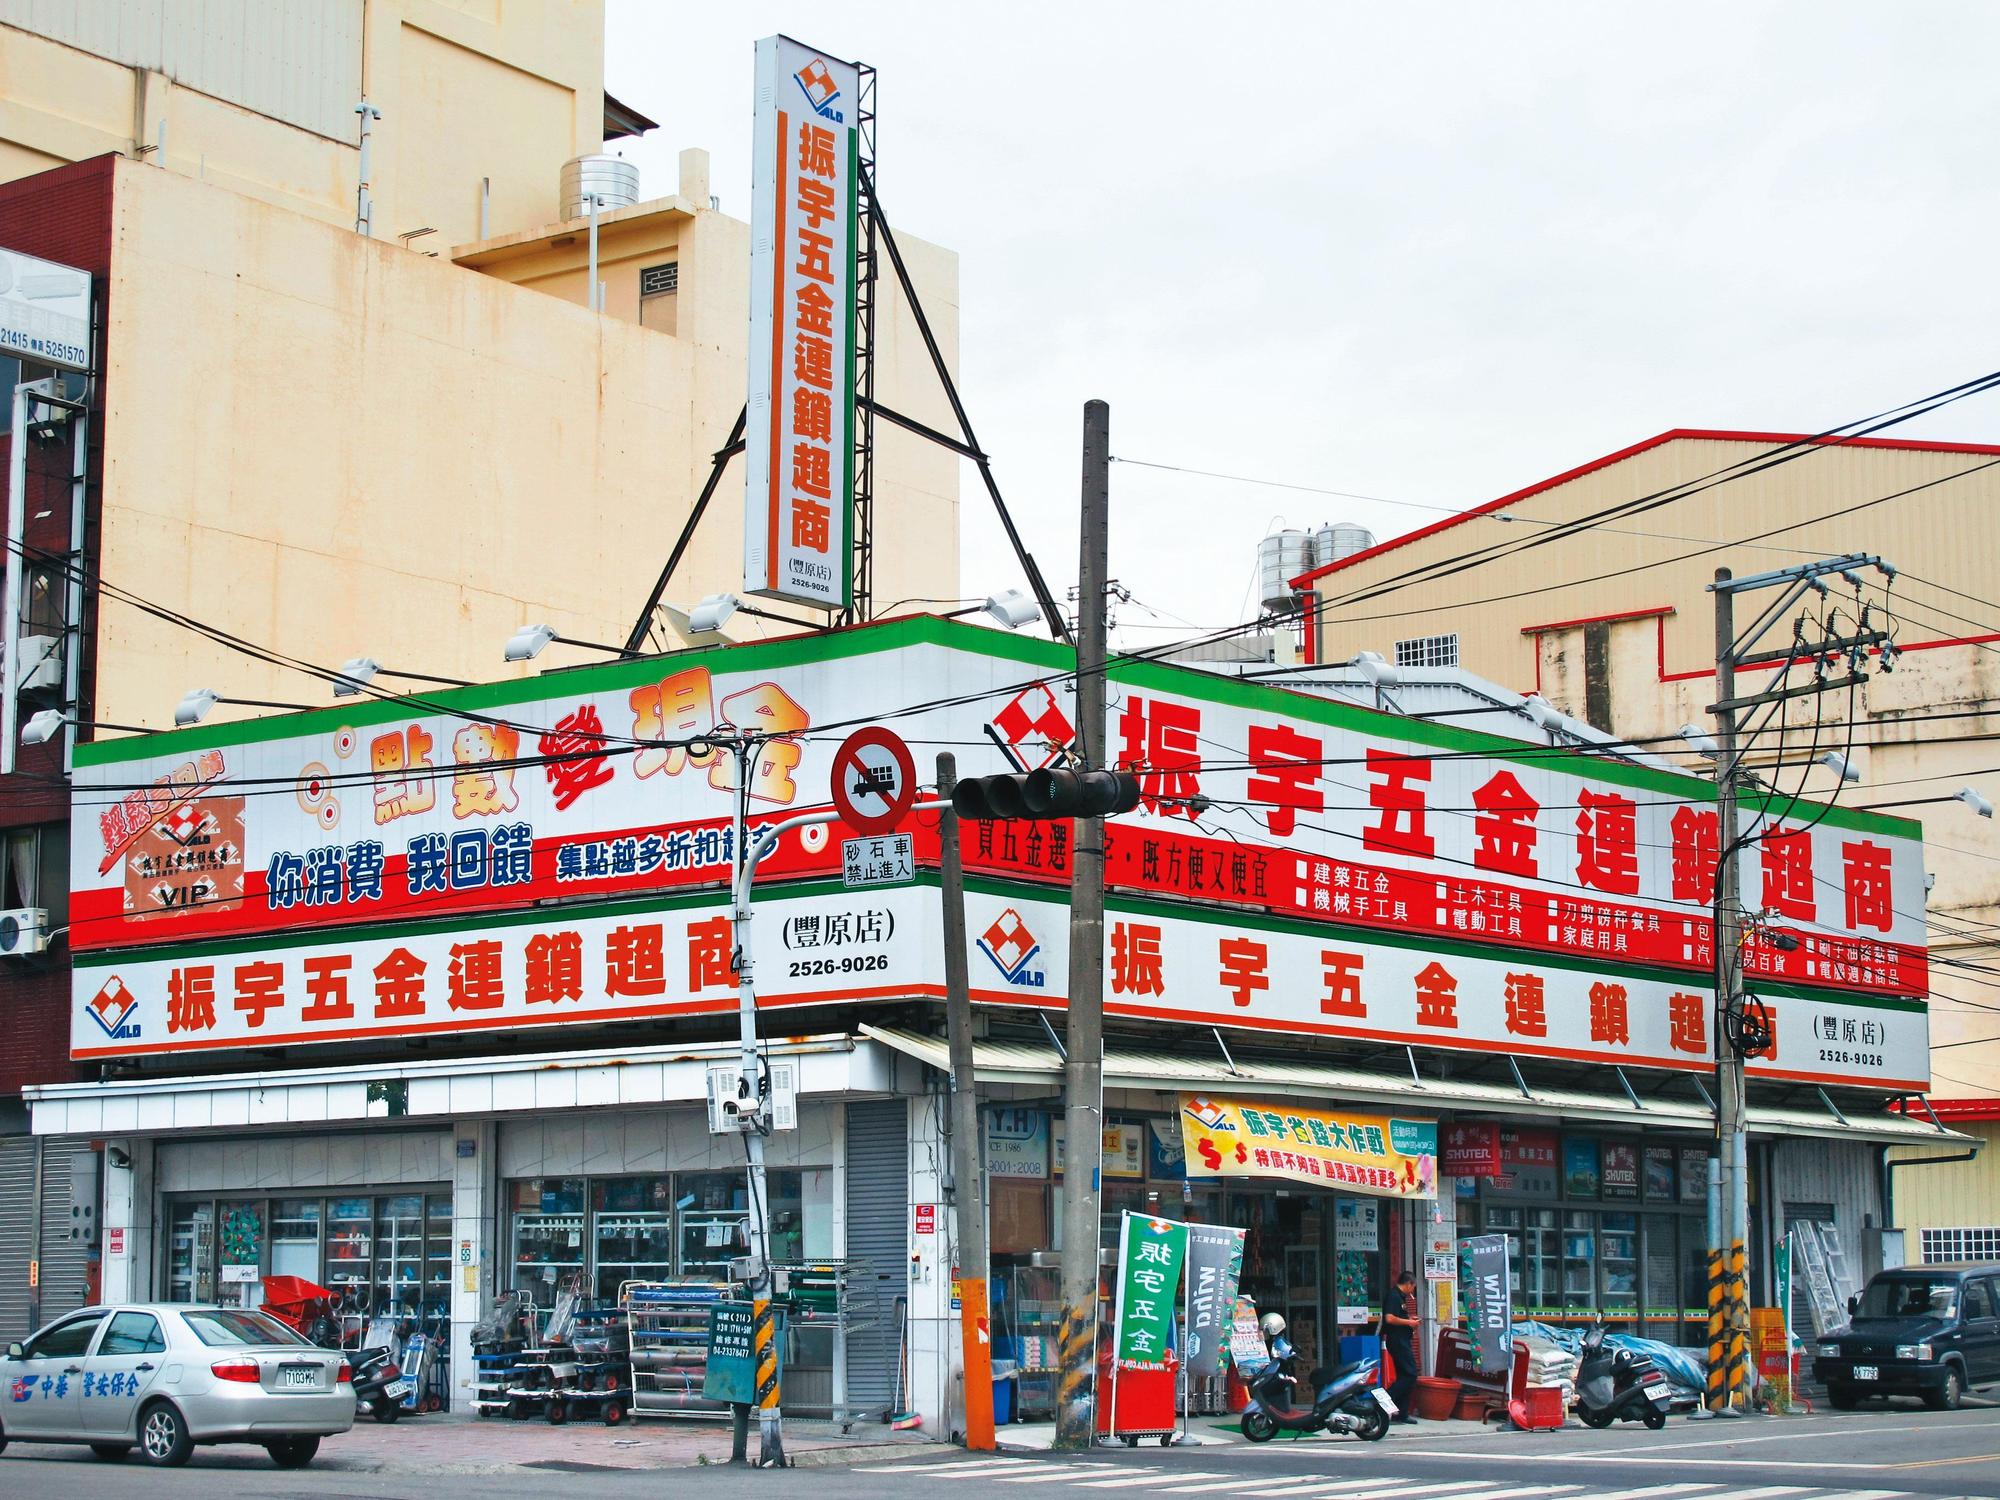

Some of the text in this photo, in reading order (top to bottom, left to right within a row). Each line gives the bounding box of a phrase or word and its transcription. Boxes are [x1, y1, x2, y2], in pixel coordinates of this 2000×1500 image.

[46, 340, 85, 364] 5251570
[791, 122, 836, 554] 振宇五金連鎖超商
[789, 556, 832, 580] (豐原店)
[791, 577, 830, 593] 2526-9026
[370, 666, 809, 825] 點數變現金
[1118, 695, 1893, 932] 振宇五金連鎖超商
[845, 838, 910, 862] 砂石車
[266, 822, 780, 912] 你消費 我回饋 集點越多折扣越多
[846, 859, 911, 884] 禁止進入
[1314, 863, 1389, 894] 建築五金
[160, 885, 208, 907] VIP
[1313, 888, 1408, 922] 機械手工具
[1452, 884, 1523, 914] 土木工具
[782, 907, 895, 952] (豐原店)
[1452, 909, 1523, 937] 電動工具
[1562, 925, 1629, 953] 家庭用具
[789, 954, 889, 977] 2526-9026
[1697, 944, 1786, 973] 汽品百貨
[166, 916, 740, 1034] 振宇五金連鎖超商
[1812, 1014, 1885, 1047] (豐原店)
[1819, 1049, 1883, 1067] 2526-9026
[1240, 1107, 1386, 1157] 振宇省錢大作戰
[41, 1375, 68, 1399] 中華
